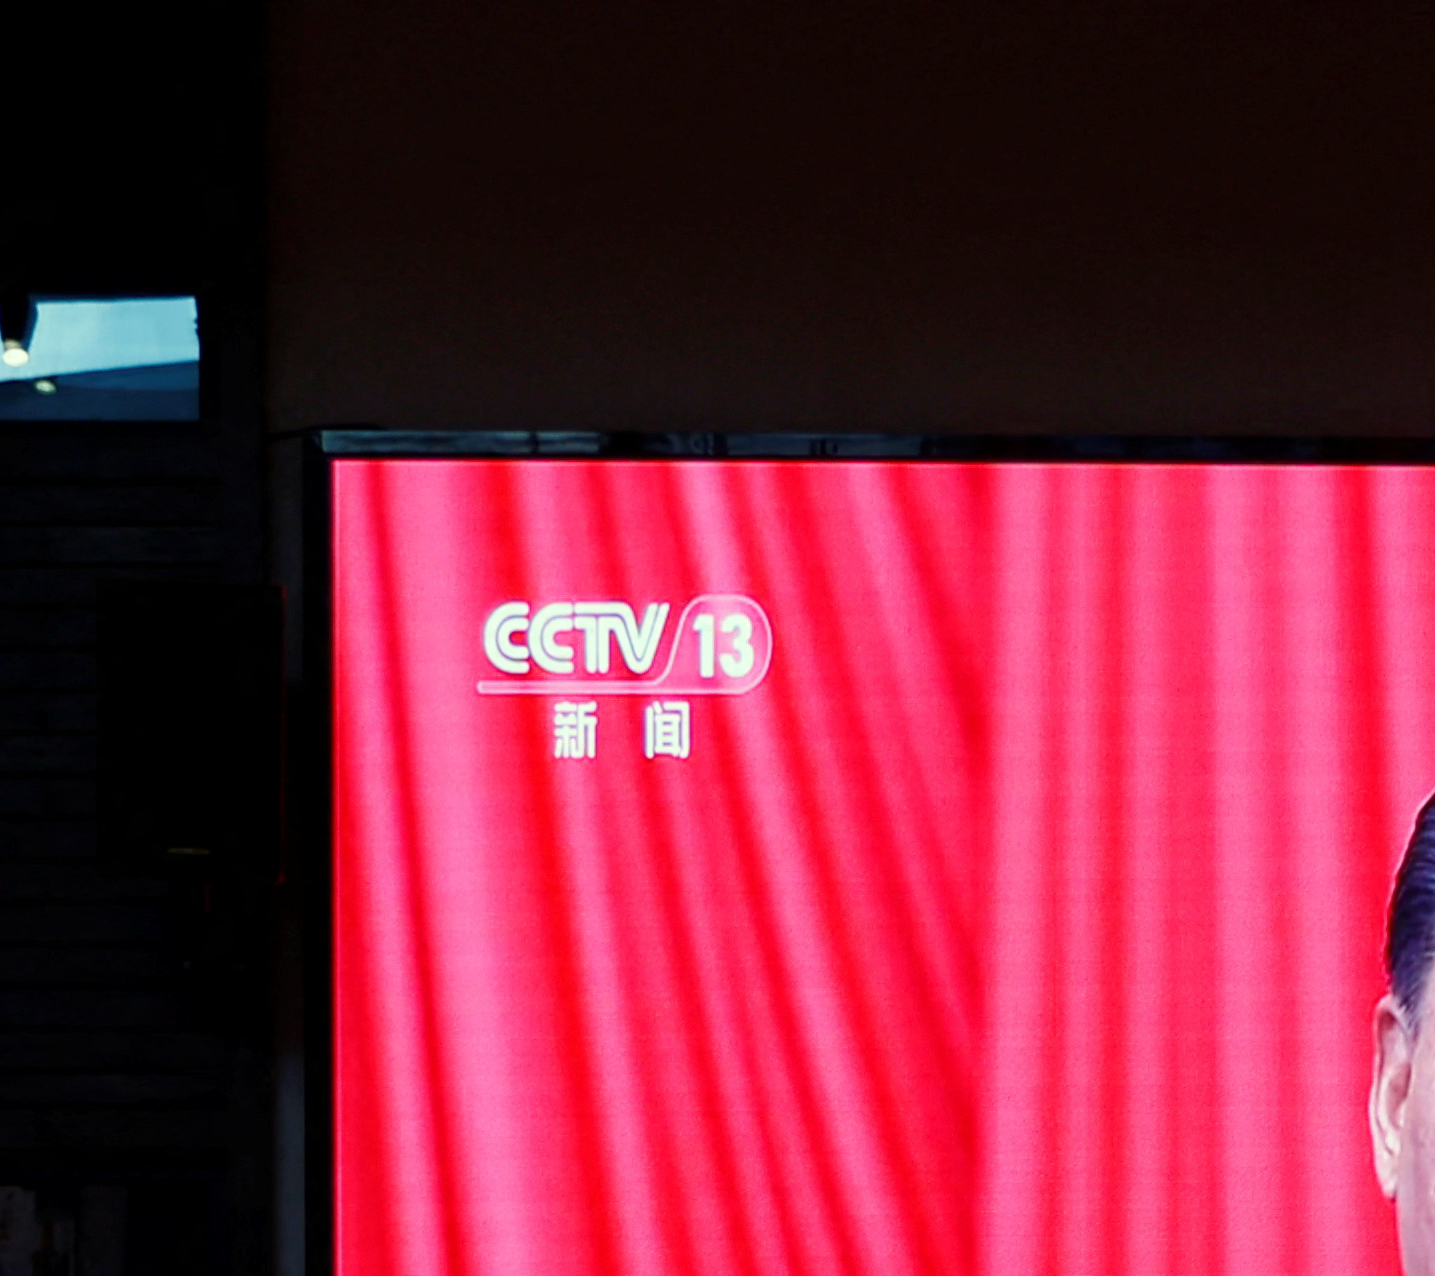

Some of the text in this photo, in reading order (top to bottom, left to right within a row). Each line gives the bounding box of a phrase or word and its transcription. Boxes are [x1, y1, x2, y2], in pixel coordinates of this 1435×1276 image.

[483, 601, 755, 678] CCTV 13
[553, 700, 691, 760] 新闻
